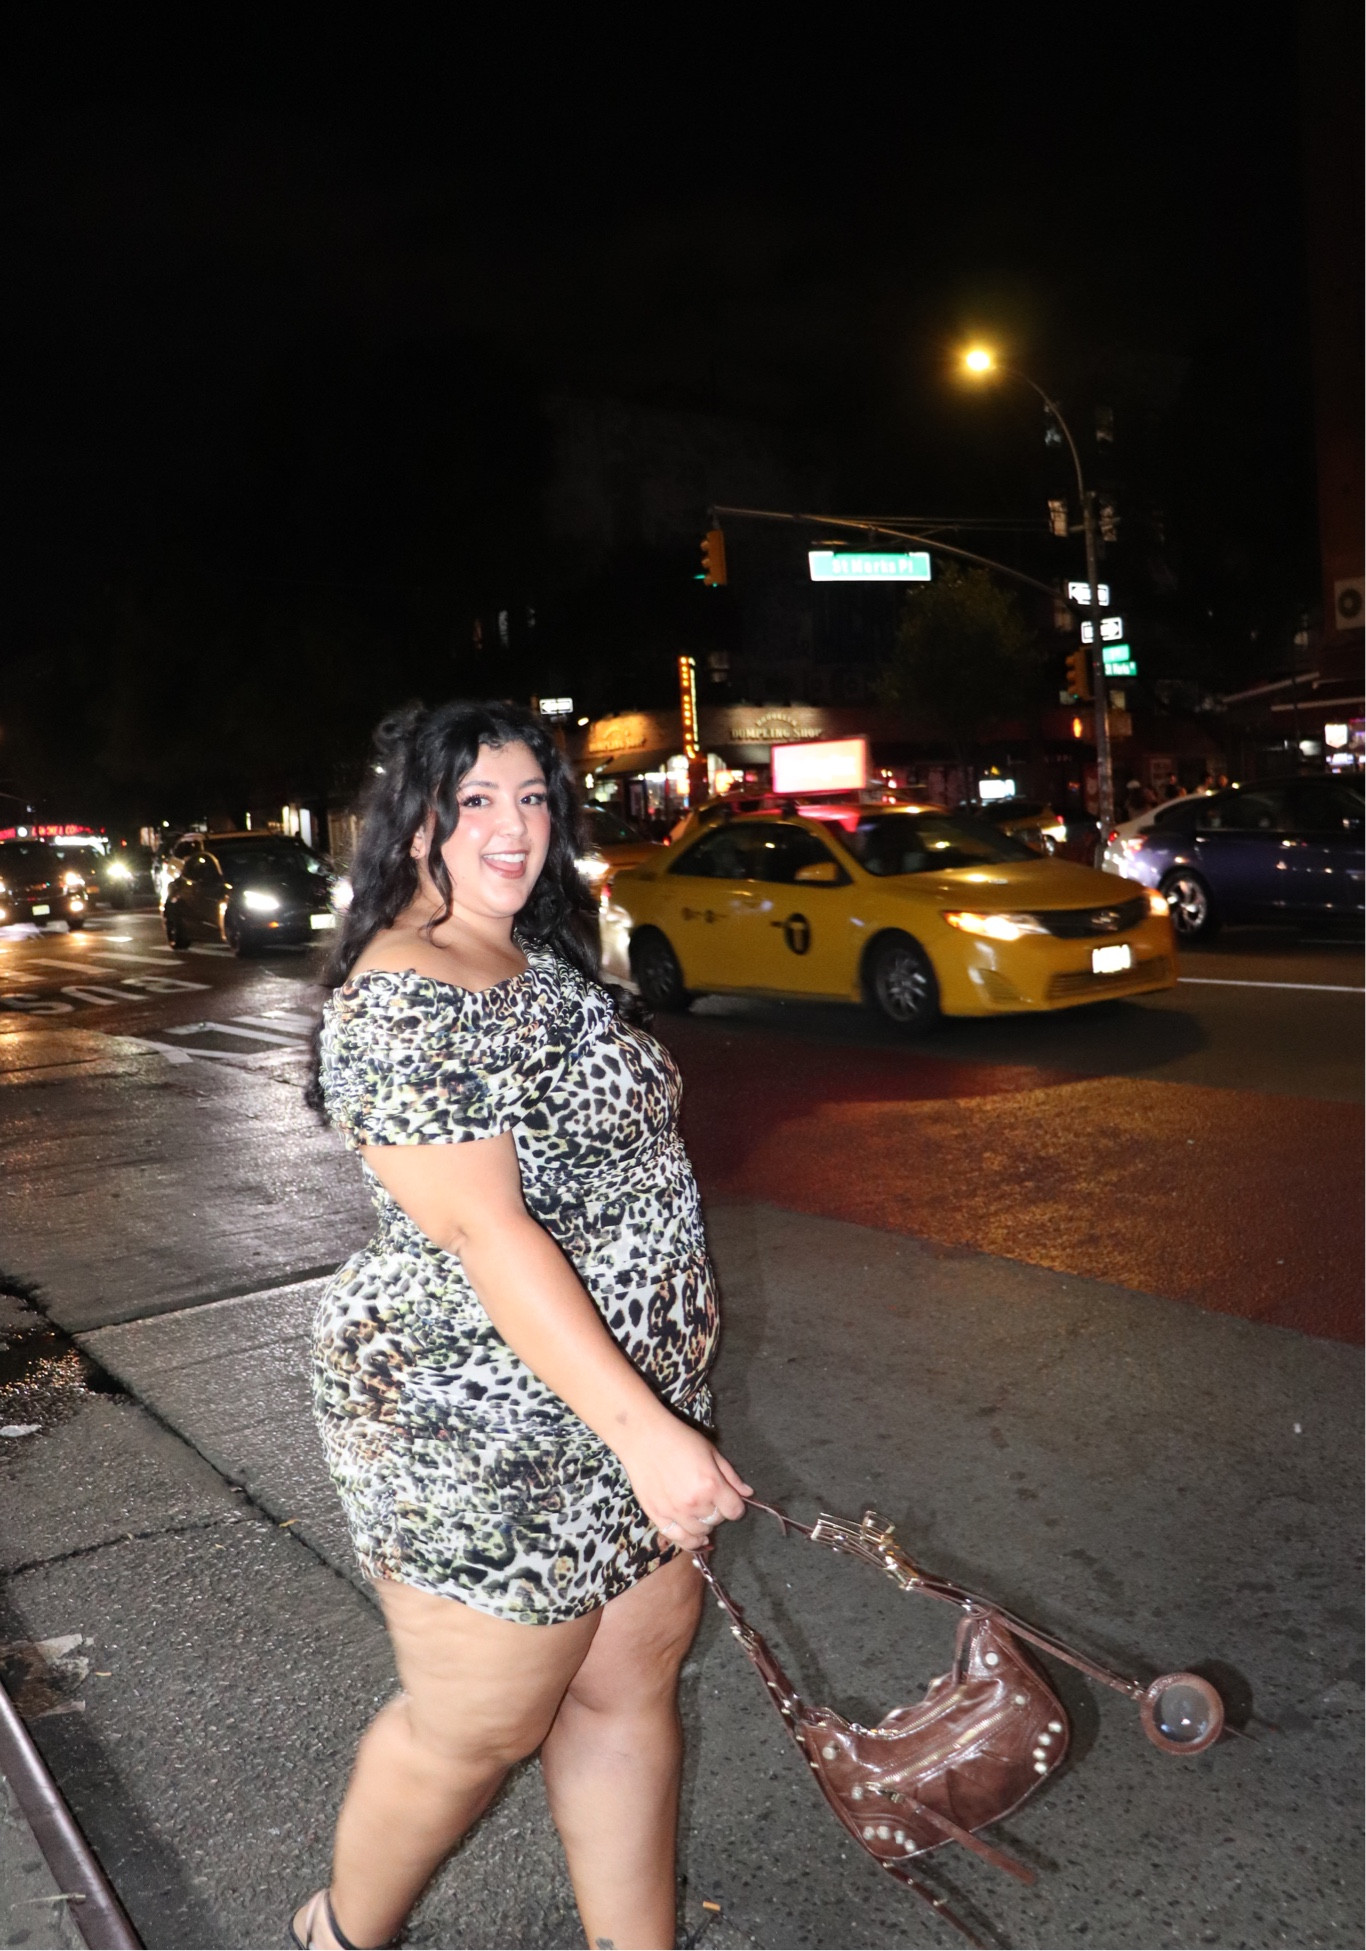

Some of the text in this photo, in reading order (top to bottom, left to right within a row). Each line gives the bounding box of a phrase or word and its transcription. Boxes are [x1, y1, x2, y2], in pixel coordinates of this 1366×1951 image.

[832, 558, 914, 575] St Marks Pl
[730, 726, 823, 739] DUMPLING SHOP
